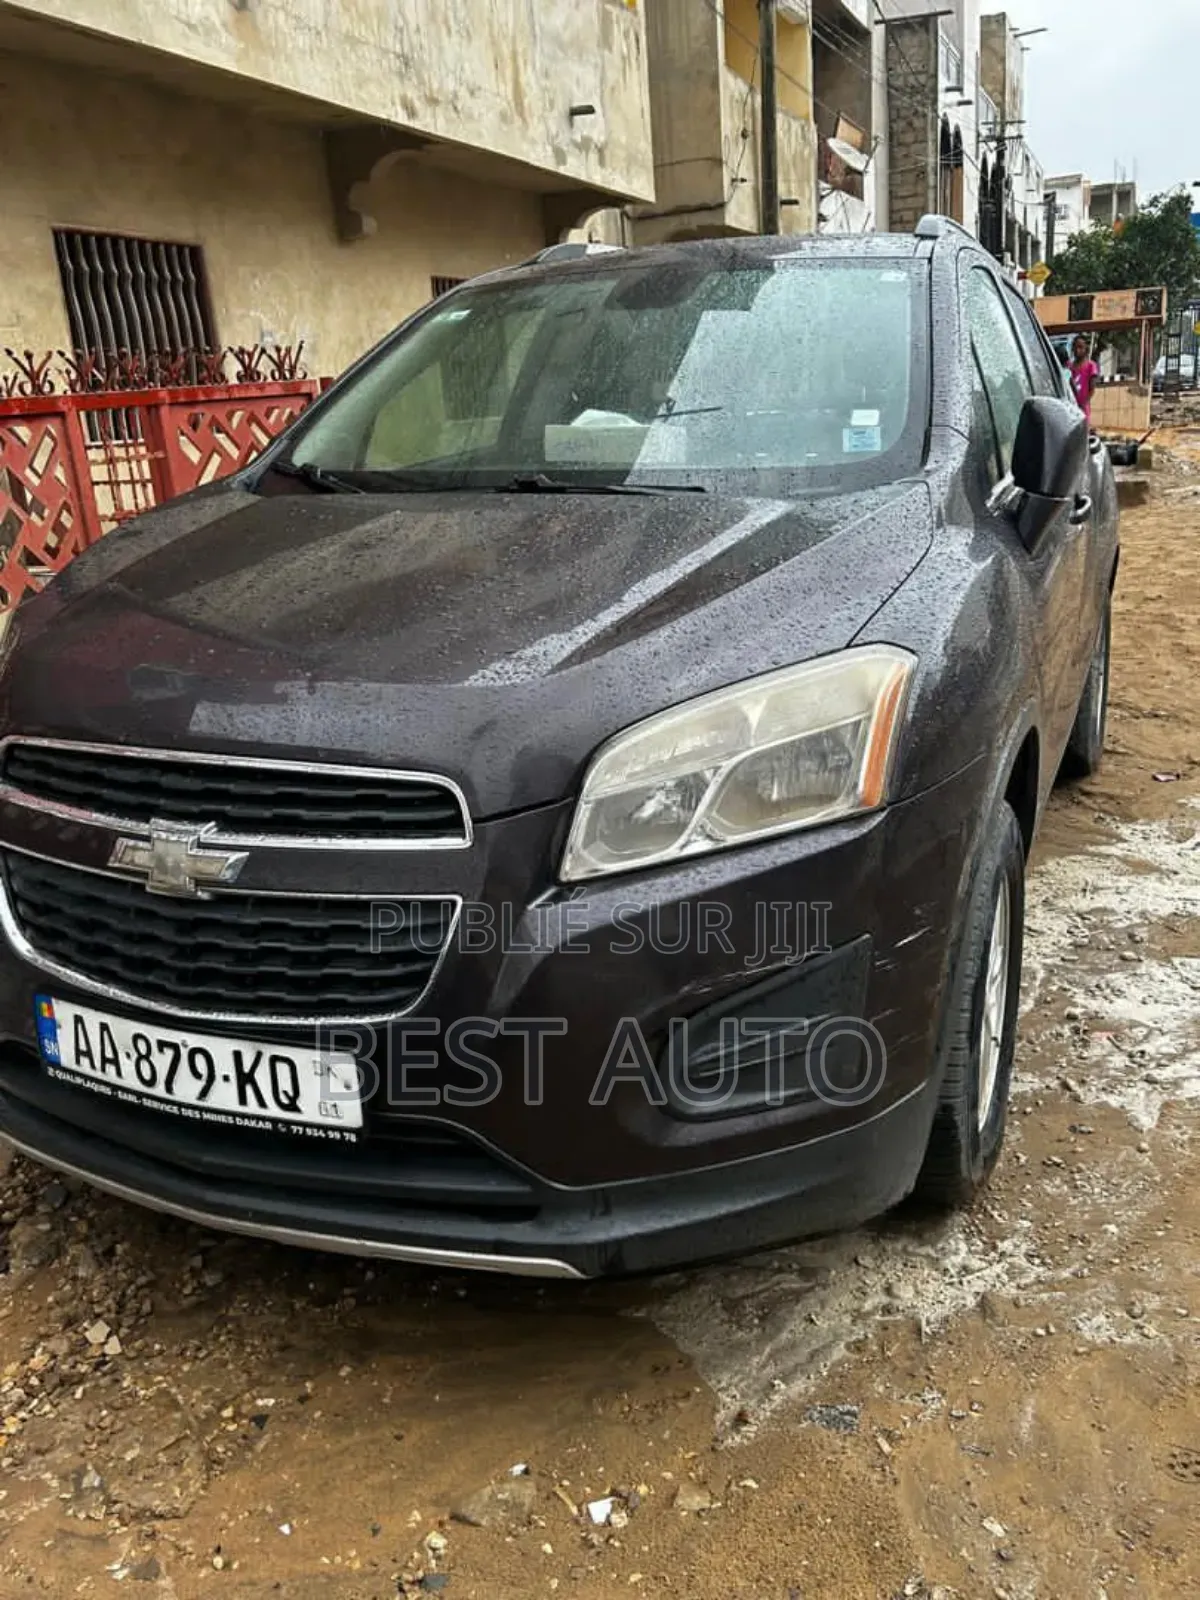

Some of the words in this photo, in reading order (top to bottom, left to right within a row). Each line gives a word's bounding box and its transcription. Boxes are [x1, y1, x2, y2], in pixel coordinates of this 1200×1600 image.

[202, 1112, 234, 1125] MINES
[236, 1117, 273, 1130] DAKAR
[291, 1125, 304, 1135] 77
